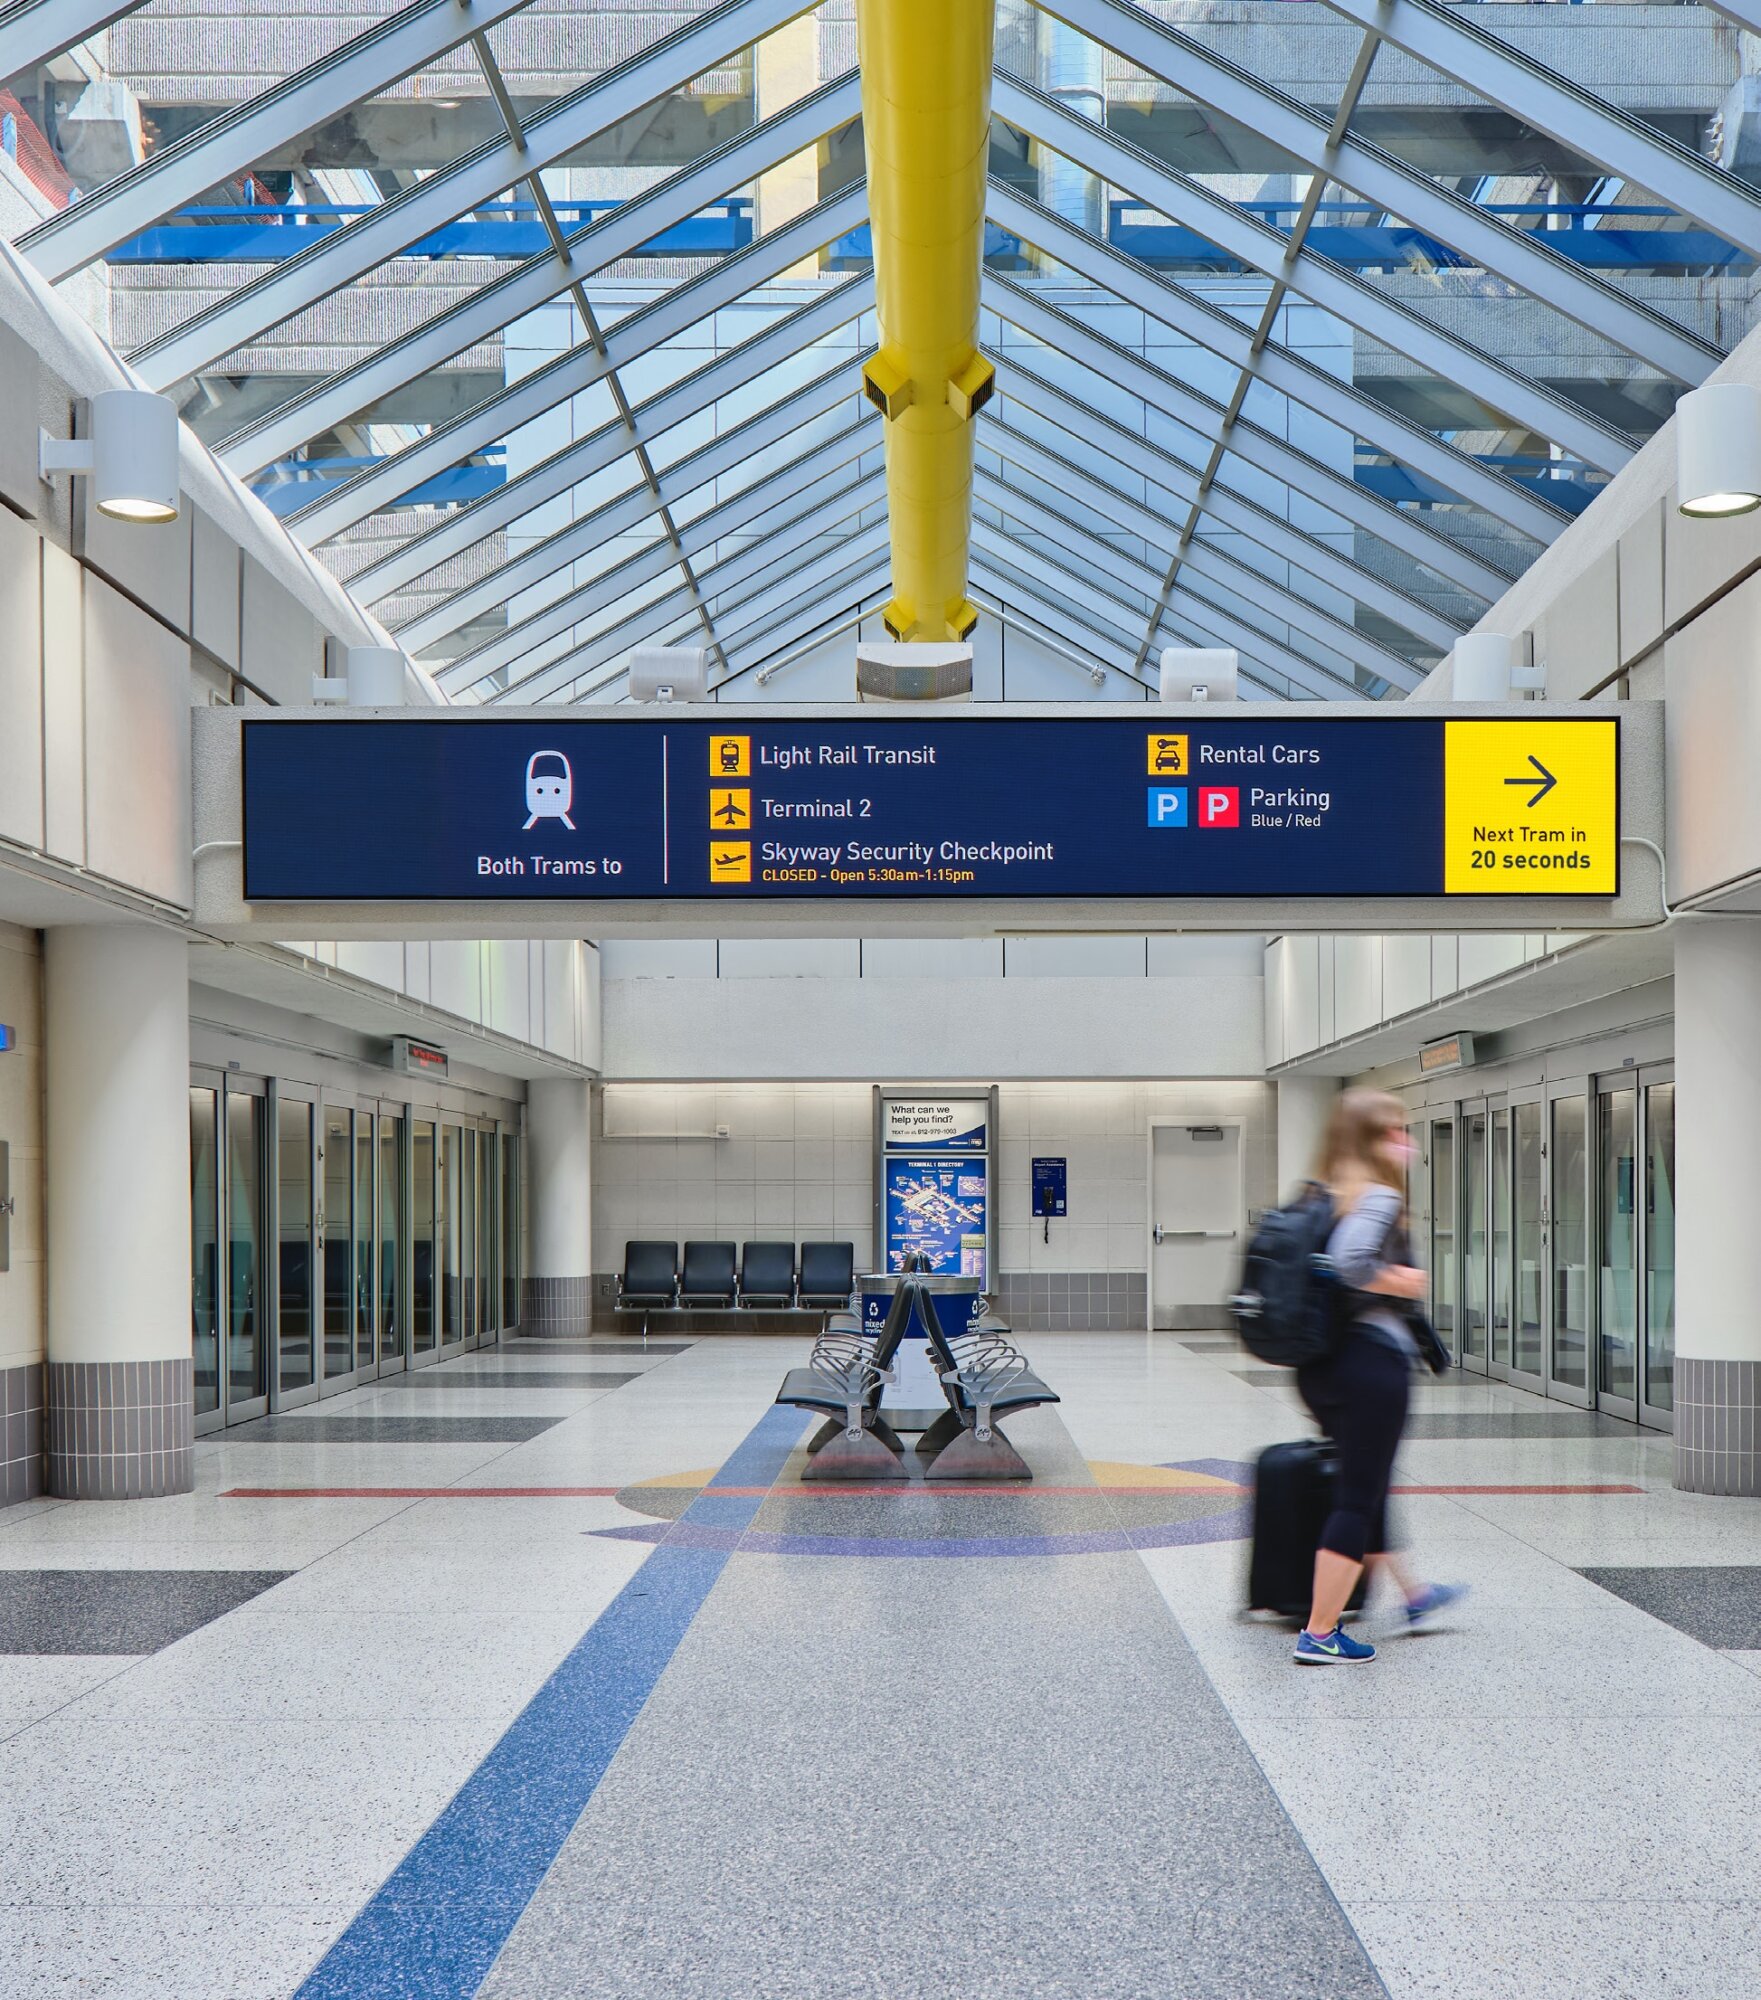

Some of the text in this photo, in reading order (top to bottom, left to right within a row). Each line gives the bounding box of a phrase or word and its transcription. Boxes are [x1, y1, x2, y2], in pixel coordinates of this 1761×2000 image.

[760, 745, 936, 770] Light Rail Transit
[1200, 744, 1320, 764] Rental Cars
[761, 798, 872, 818] Terminal 2
[1157, 793, 1230, 822] P P
[1251, 788, 1330, 811] Parking
[1251, 814, 1284, 828] Blue
[1295, 813, 1321, 828] Red
[1473, 826, 1587, 843] Next Tram in
[761, 841, 1054, 866] Skyway Security Checkpoint
[1471, 850, 1591, 870] 20 seconds
[477, 856, 623, 876] Both Trams to
[762, 868, 817, 882] CLOSED
[830, 868, 865, 884] Open
[868, 868, 974, 884] 5:30am-1:15pm
[891, 1105, 916, 1114] What
[891, 1115, 954, 1125] help you find?
[864, 1318, 886, 1328] mixed
